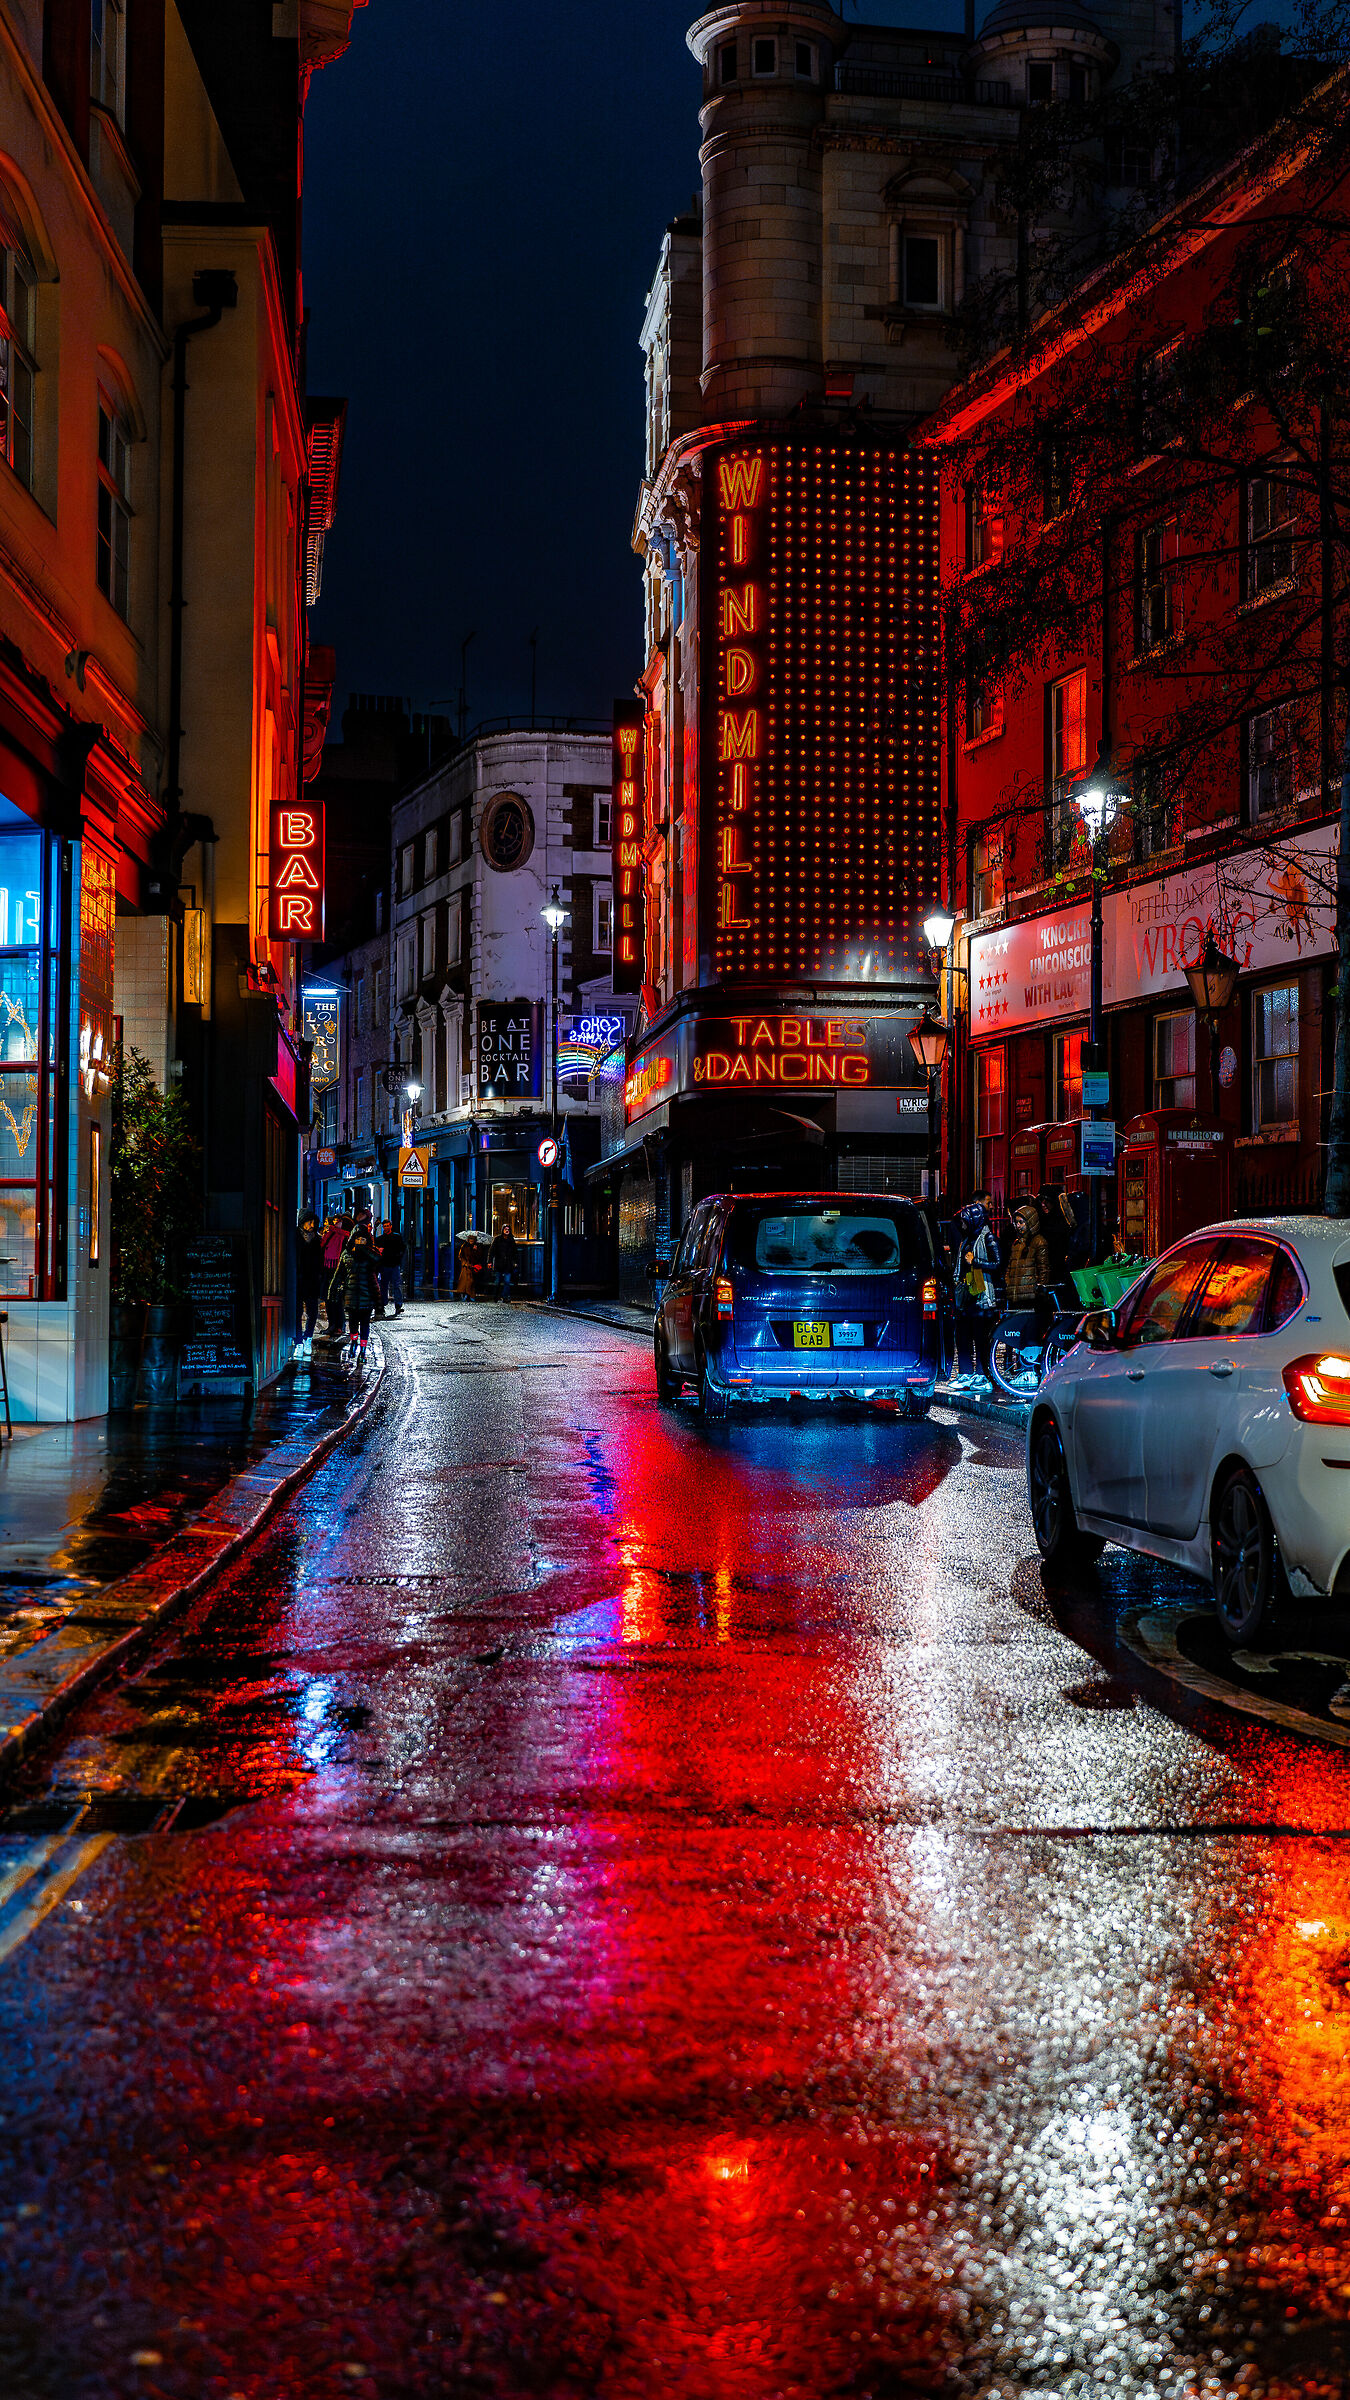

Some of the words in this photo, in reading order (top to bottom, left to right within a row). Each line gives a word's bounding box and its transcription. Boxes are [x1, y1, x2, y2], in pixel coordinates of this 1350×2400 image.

[719, 458, 762, 929] WINDMILL
[620, 729, 637, 961] WINDMILL
[276, 812, 319, 930] BAR
[1131, 891, 1170, 926] PETER
[1030, 943, 1092, 980] UNCONSCIO
[1024, 984, 1052, 1008] WITH
[315, 1002, 336, 1011] THE
[481, 1019, 497, 1032] BE
[507, 1018, 530, 1031] AT
[730, 1019, 867, 1047] TABLES
[306, 1011, 335, 1071] LYRIC
[481, 1033, 531, 1052] ONE
[481, 1053, 530, 1062] COCKTAIL
[481, 1063, 530, 1083] BAR
[902, 1098, 928, 1107] LYRIC
[1169, 1131, 1224, 1140] TELEPHO
[796, 1323, 826, 1334] GC67
[801, 1335, 823, 1346] CAB
